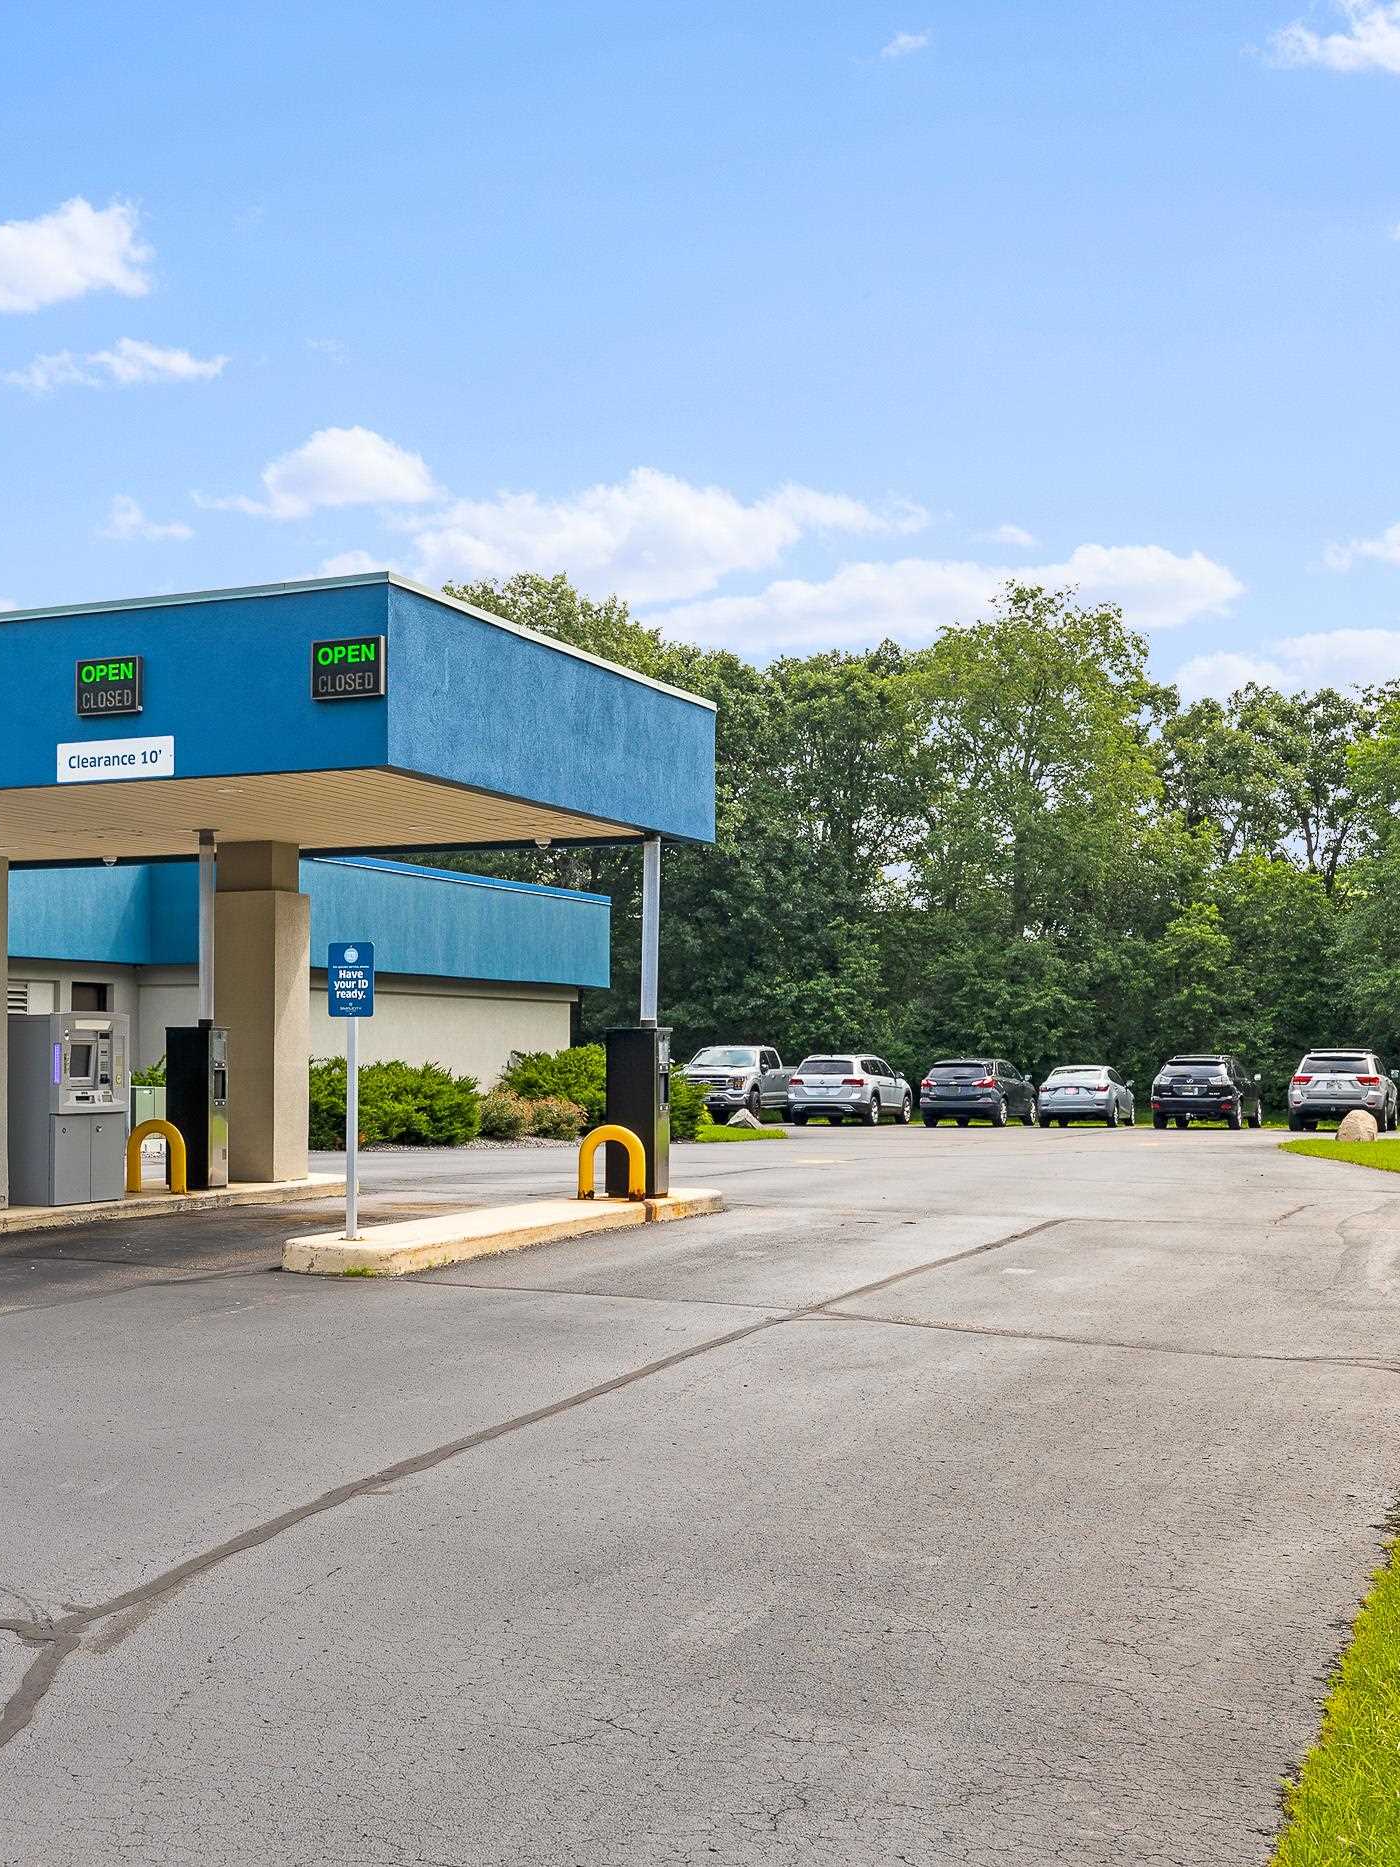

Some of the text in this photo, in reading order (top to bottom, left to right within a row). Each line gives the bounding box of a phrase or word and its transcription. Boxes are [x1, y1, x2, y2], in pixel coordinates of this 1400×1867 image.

[317, 643, 375, 666] OPEN
[81, 662, 134, 684] OPEN
[318, 672, 374, 693] CLOSED
[82, 689, 132, 709] CLOSED
[68, 753, 136, 769] Clearance
[338, 969, 364, 978] Have
[334, 979, 369, 991] your ID
[336, 990, 366, 1000] ready.
